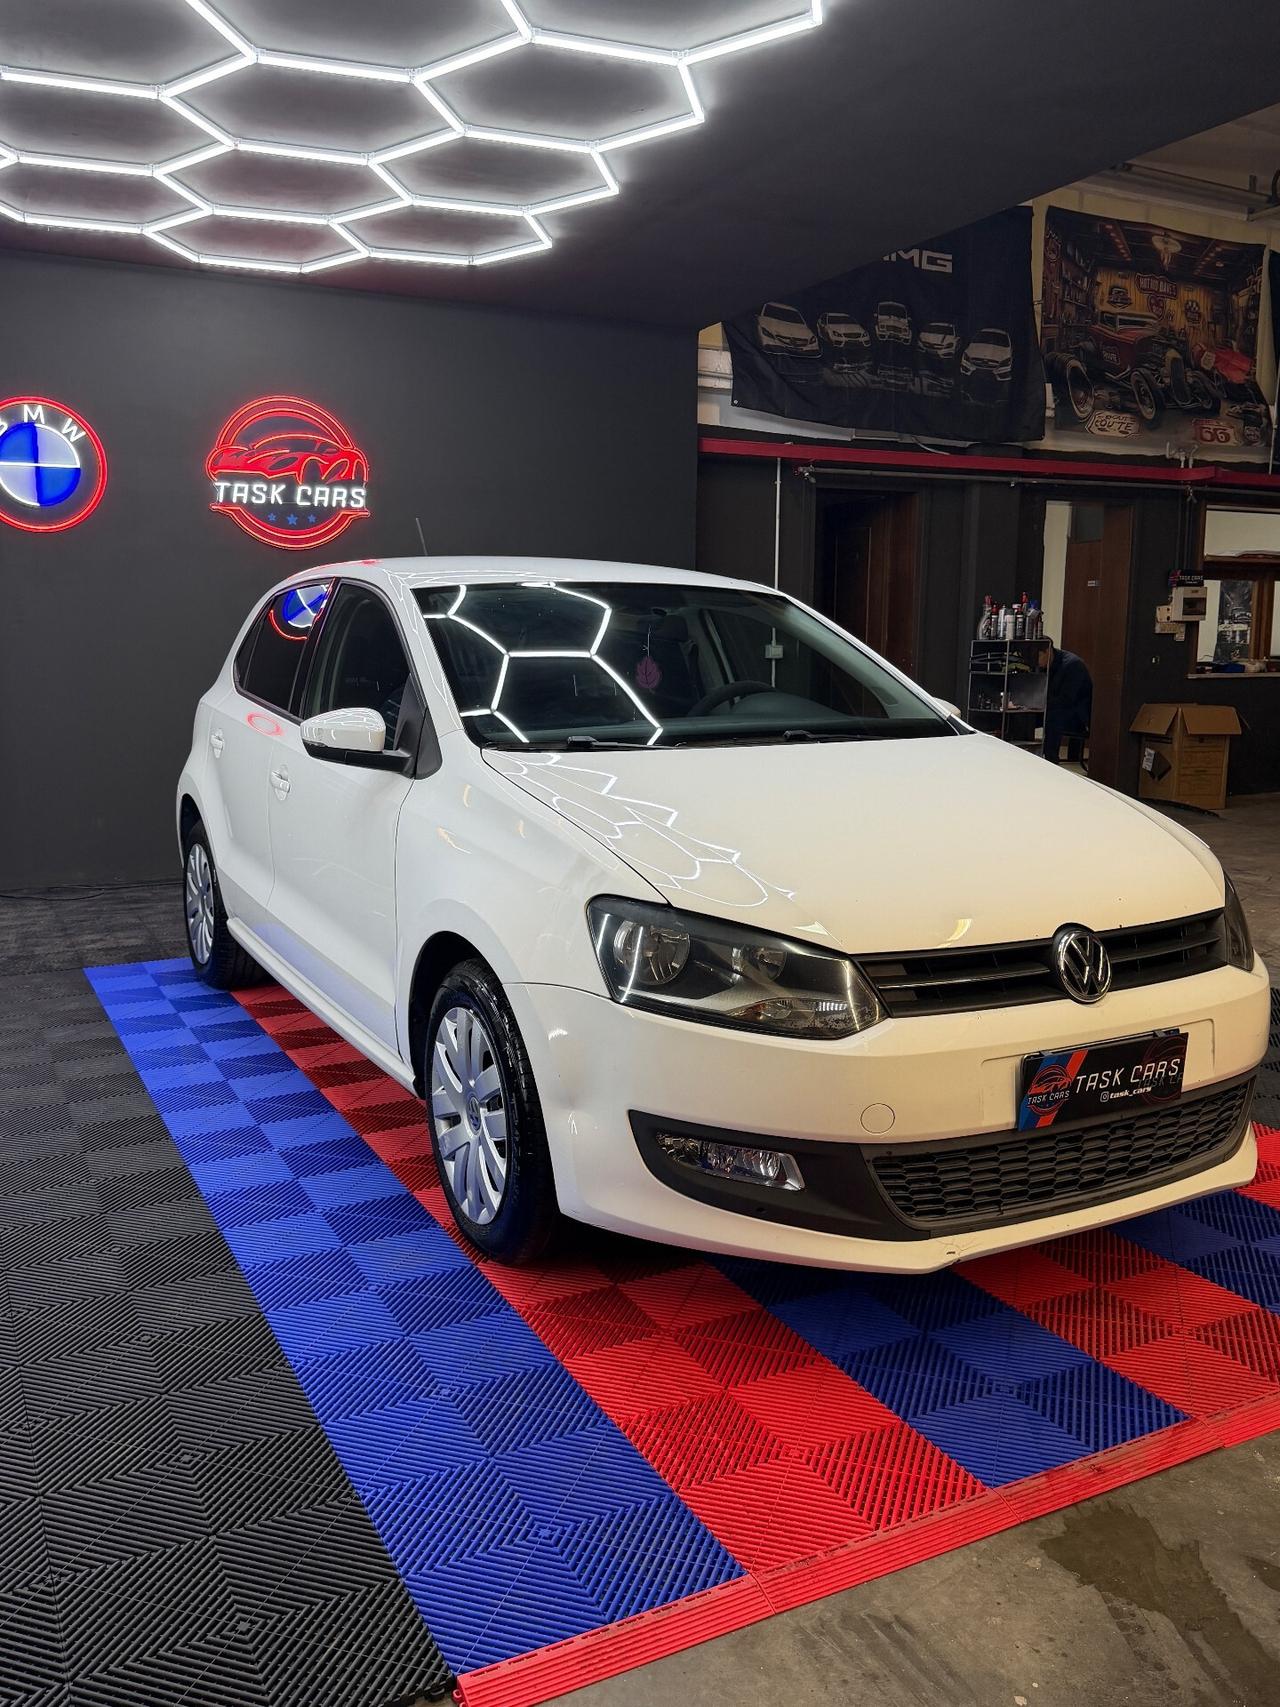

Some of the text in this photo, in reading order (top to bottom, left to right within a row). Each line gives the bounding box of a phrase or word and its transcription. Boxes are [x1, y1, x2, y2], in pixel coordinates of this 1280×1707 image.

[1200, 427, 1230, 443] 66
[214, 482, 367, 508] TASK CARS
[1075, 1058, 1180, 1093] TASK CARS
[1027, 1090, 1070, 1106] TASK CARS
